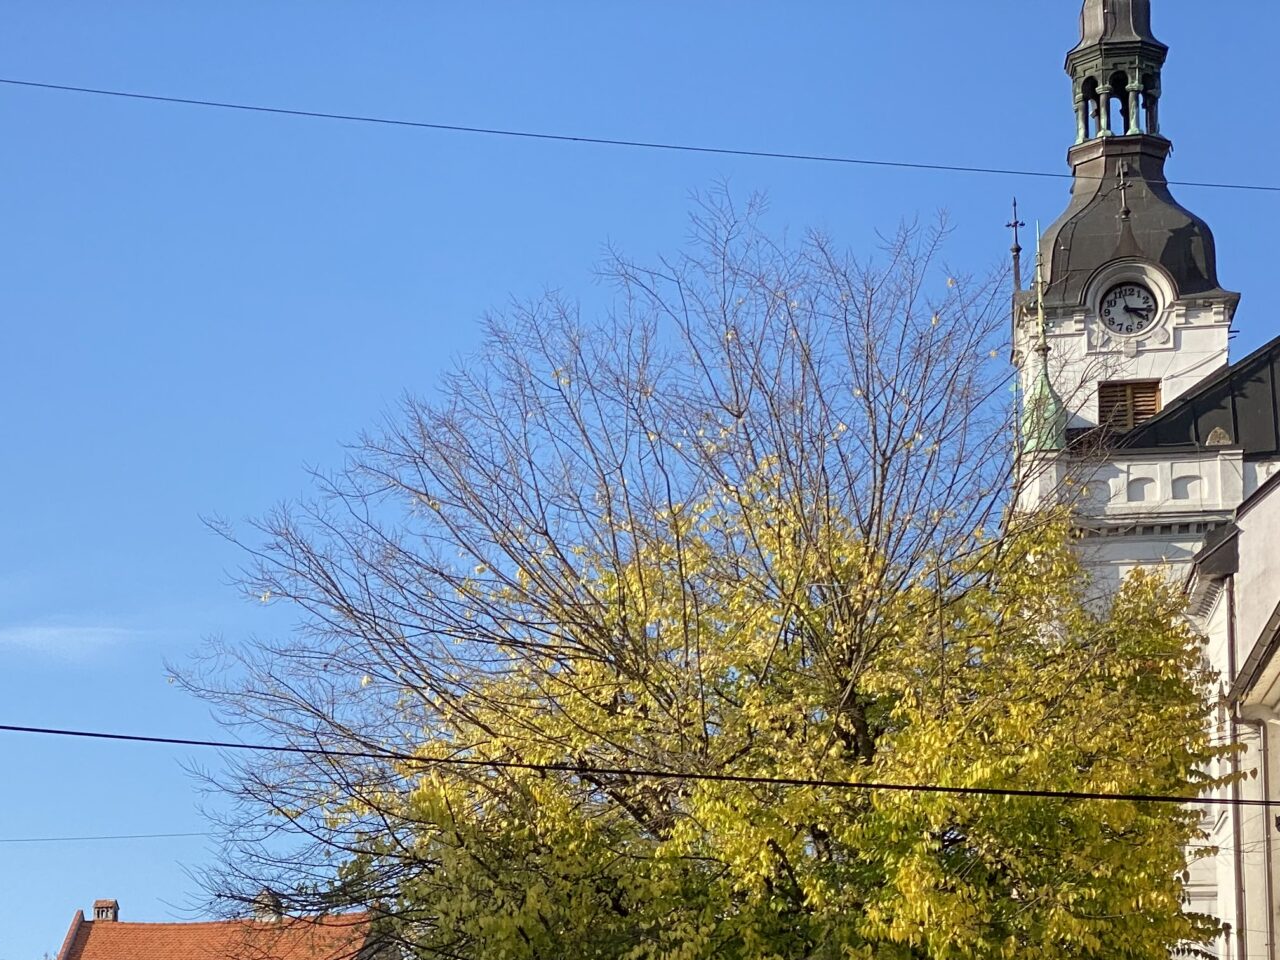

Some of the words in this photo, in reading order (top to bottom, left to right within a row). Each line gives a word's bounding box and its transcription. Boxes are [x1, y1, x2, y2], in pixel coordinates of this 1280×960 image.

[1124, 288, 1135, 296] 12
[1142, 296, 1150, 304] 2
[1104, 309, 1111, 317] 9
[1108, 317, 1115, 326] 8
[1136, 321, 1143, 330] 5
[1117, 323, 1124, 332] 7
[1126, 325, 1133, 333] 6
